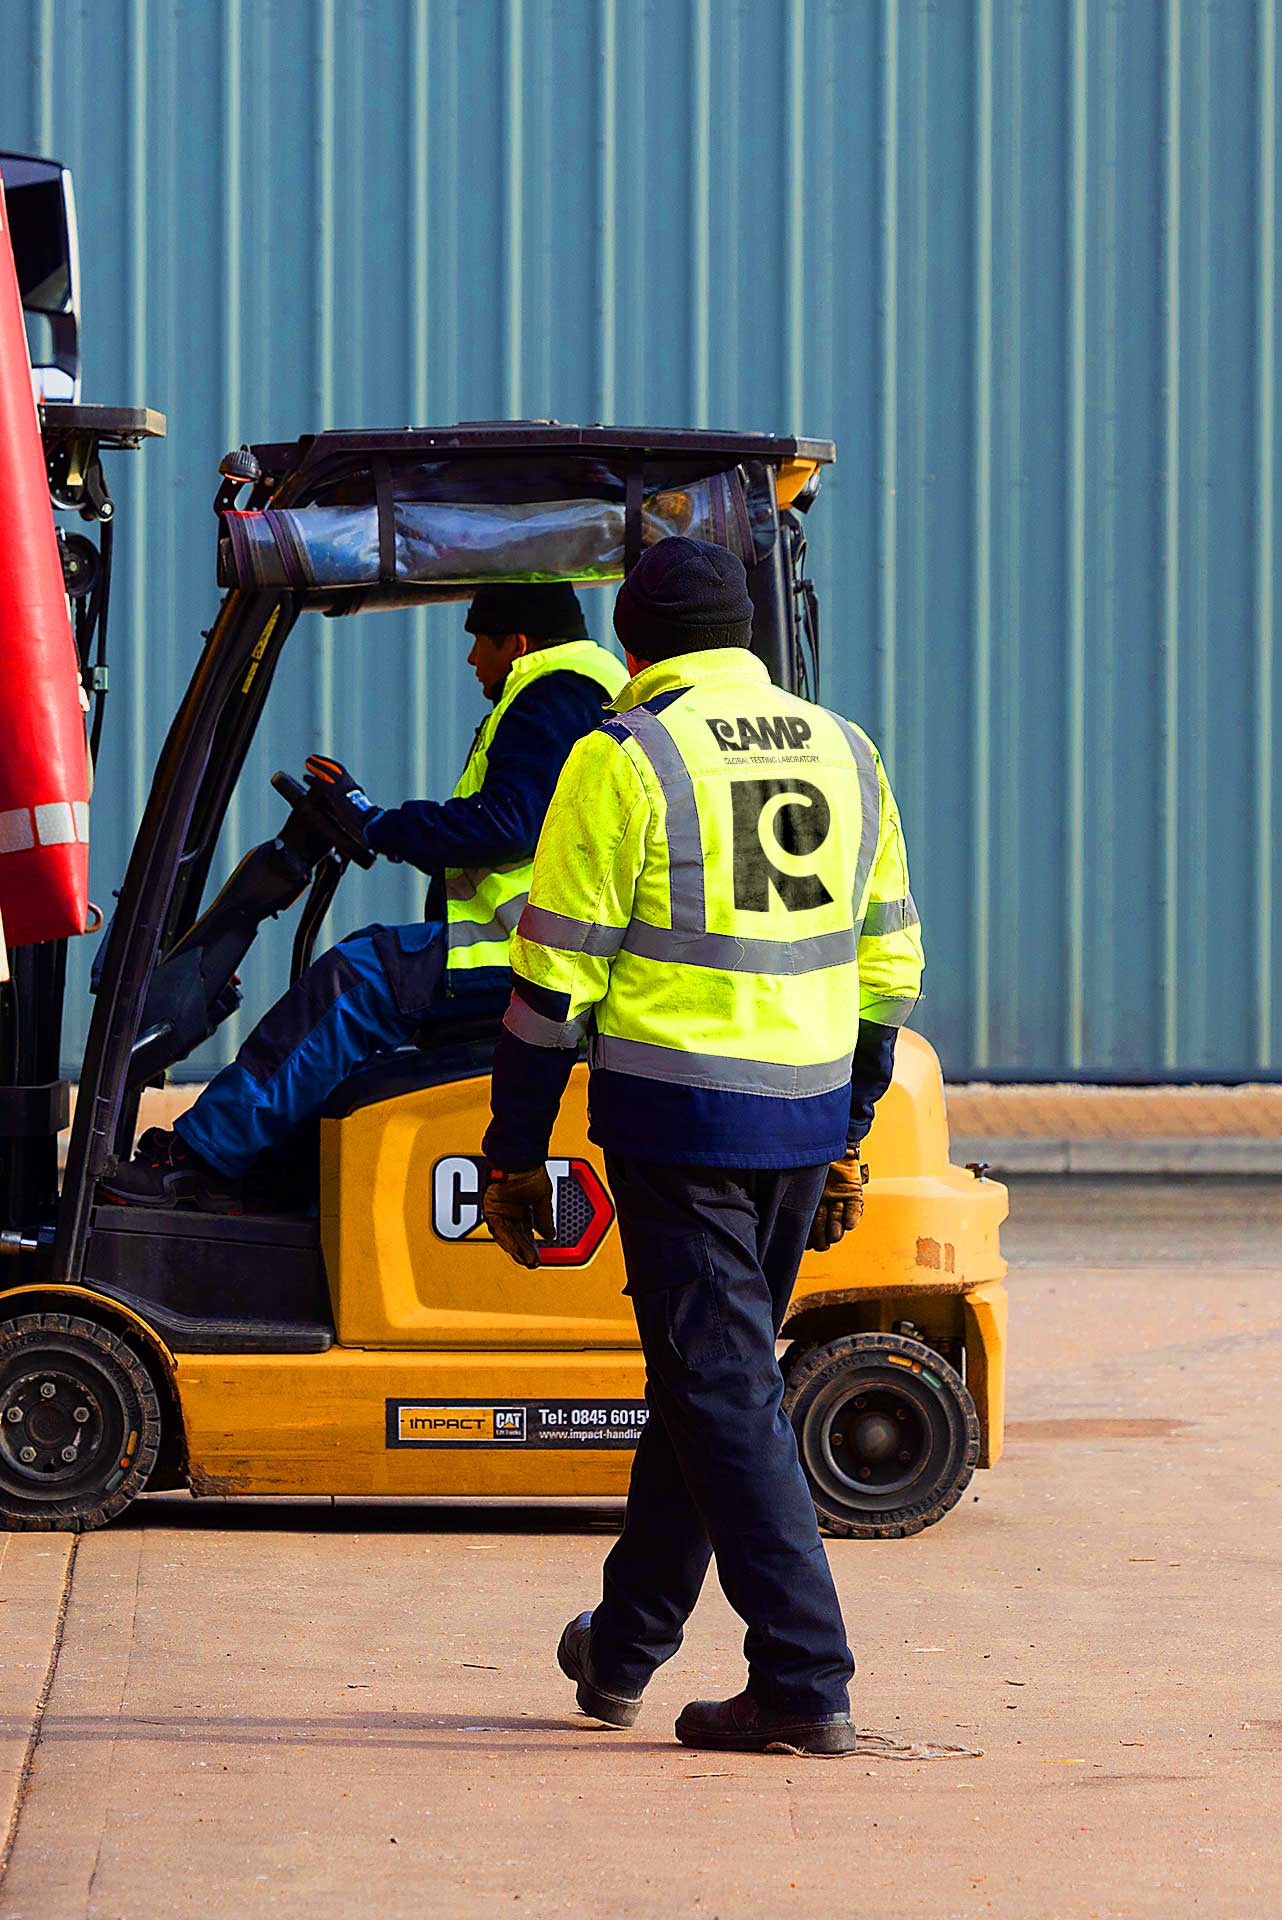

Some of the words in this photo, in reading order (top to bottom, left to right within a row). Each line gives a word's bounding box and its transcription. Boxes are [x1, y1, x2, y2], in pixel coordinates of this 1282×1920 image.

[724, 757, 749, 765] GLOBAL
[750, 756, 777, 764] TESTING
[778, 755, 820, 764] LABORATORY
[435, 1157, 570, 1240] CT
[496, 1412, 522, 1428] CAT
[539, 1409, 568, 1425] Tel:
[571, 1409, 607, 1425] 0845
